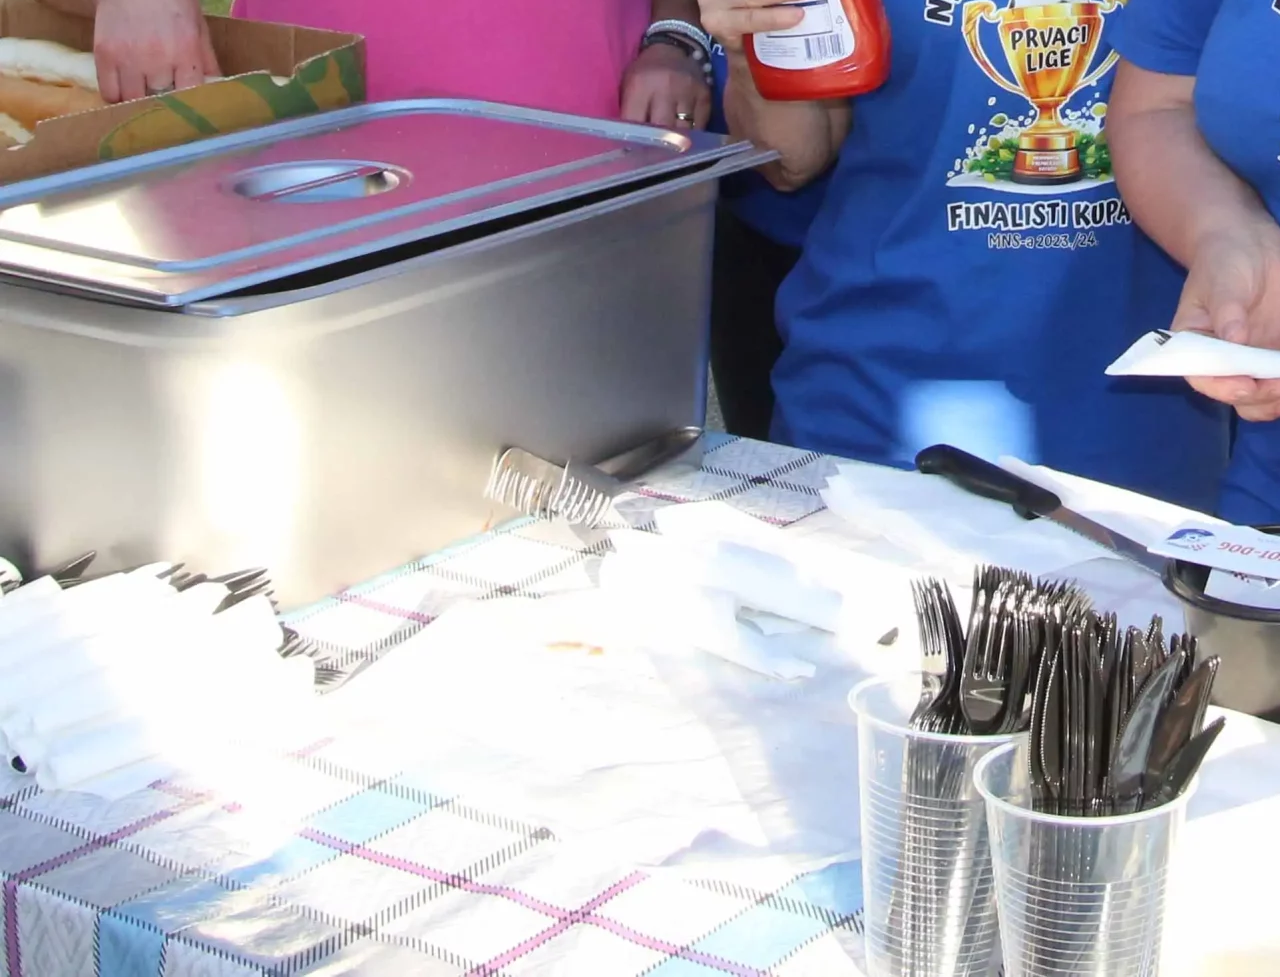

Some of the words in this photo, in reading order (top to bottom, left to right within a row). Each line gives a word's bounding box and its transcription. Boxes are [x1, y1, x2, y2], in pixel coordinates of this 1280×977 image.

[1010, 25, 1088, 50] PRVACI
[1026, 49, 1072, 73] LIGE
[948, 201, 1068, 230] FINALISTI
[1074, 199, 1131, 229] KUPA
[988, 233, 1034, 249] MNS-a
